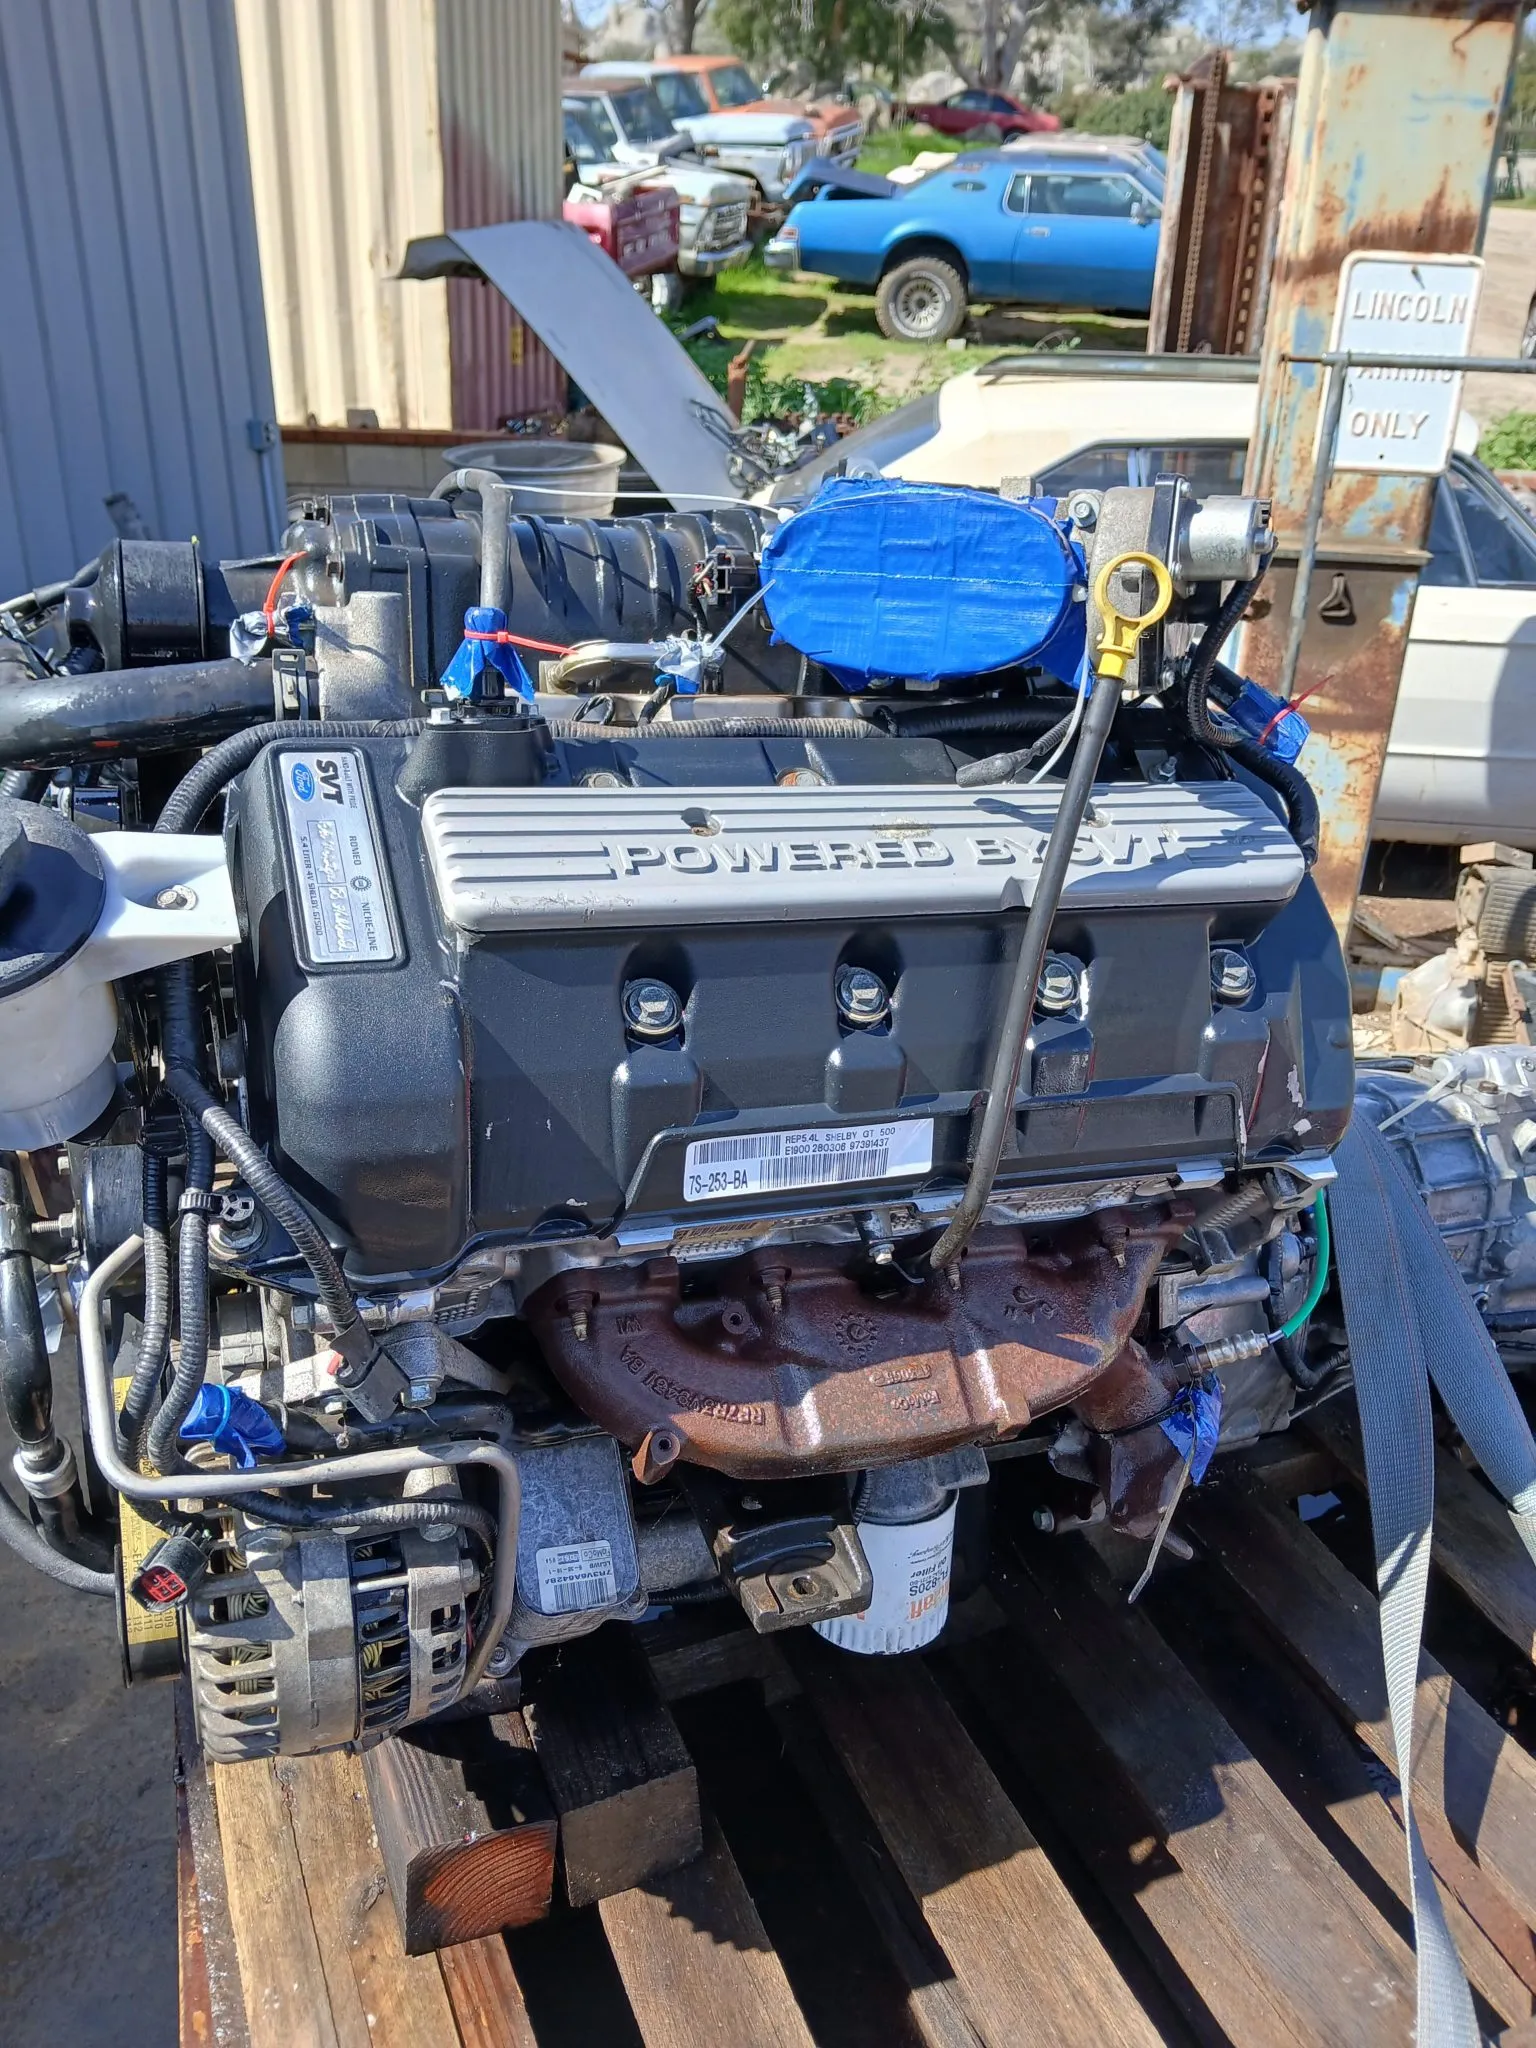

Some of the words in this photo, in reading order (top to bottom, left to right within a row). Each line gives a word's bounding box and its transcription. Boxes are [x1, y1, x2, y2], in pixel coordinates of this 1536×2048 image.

[1352, 291, 1469, 324] LINCOLN
[1351, 411, 1430, 440] ONLY
[316, 759, 344, 805] SVT
[301, 848, 312, 869] LITER
[349, 835, 362, 866] ROMEO
[617, 837, 954, 875] POWERED
[967, 833, 1050, 866] BY
[1068, 829, 1177, 866] SVT
[361, 902, 378, 952] NICHE-LINE
[825, 1131, 857, 1142] SHELBY
[862, 1129, 875, 1139] GT
[880, 1127, 896, 1137] 500
[849, 1138, 890, 1151] 97391437
[689, 1168, 749, 1196] 7S-253-BA
[909, 1566, 949, 1597] FL-820S
[910, 1563, 936, 1579] Filter
[133, 1616, 143, 1633] 112
[144, 1613, 153, 1631] 111
[164, 1610, 174, 1628] 109
